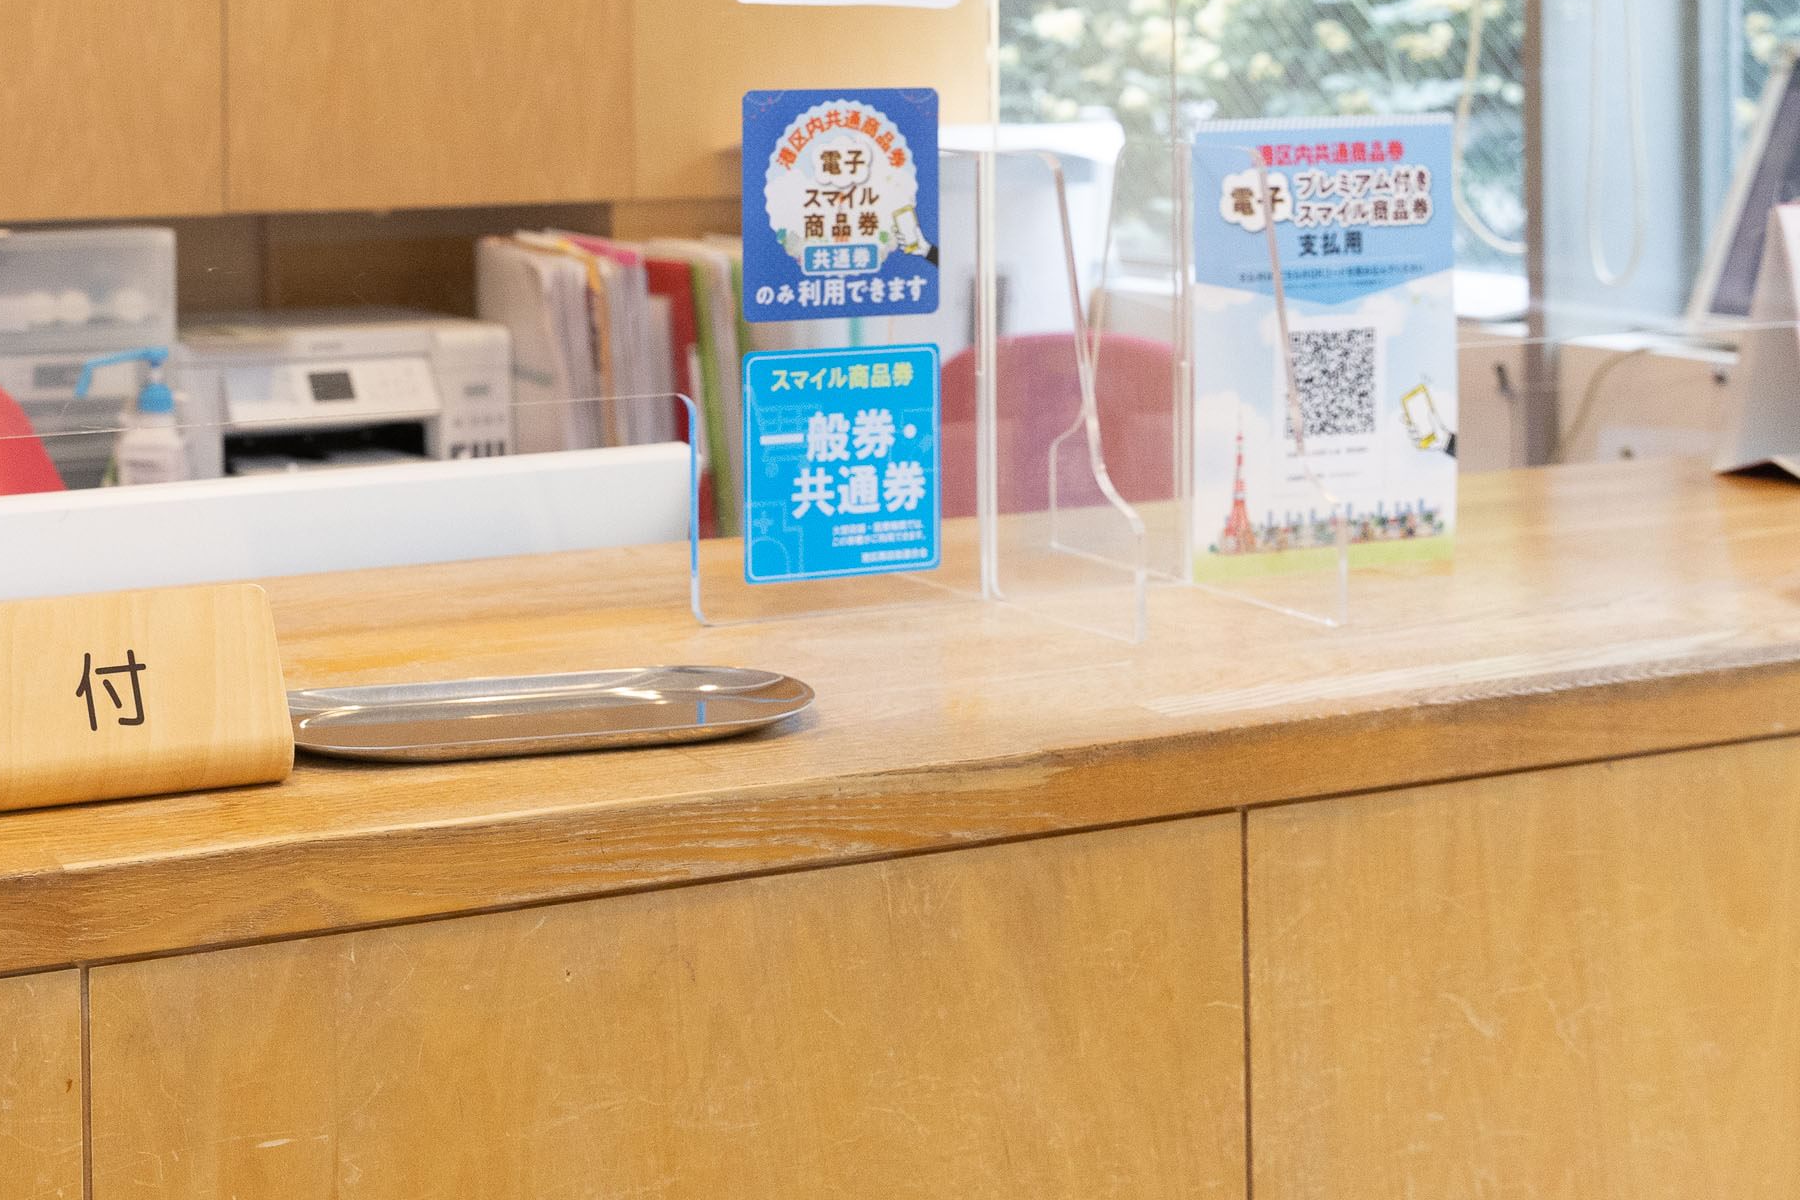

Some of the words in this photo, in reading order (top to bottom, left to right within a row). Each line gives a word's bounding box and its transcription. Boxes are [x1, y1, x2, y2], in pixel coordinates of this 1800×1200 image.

[777, 110, 906, 170] 港区内共通商品券
[820, 150, 865, 175] 電子
[1298, 171, 1427, 195] プレミアム付き
[803, 187, 879, 208] スマイル
[1231, 187, 1284, 216] 電子
[1299, 198, 1428, 222] スマイル商品券
[805, 212, 879, 238] 商品券
[1298, 231, 1363, 257] 支払用
[812, 249, 871, 269] 共通券
[756, 275, 927, 307] のみ利用できます
[771, 361, 914, 392] スマイル商品券
[791, 461, 927, 519] 共通券
